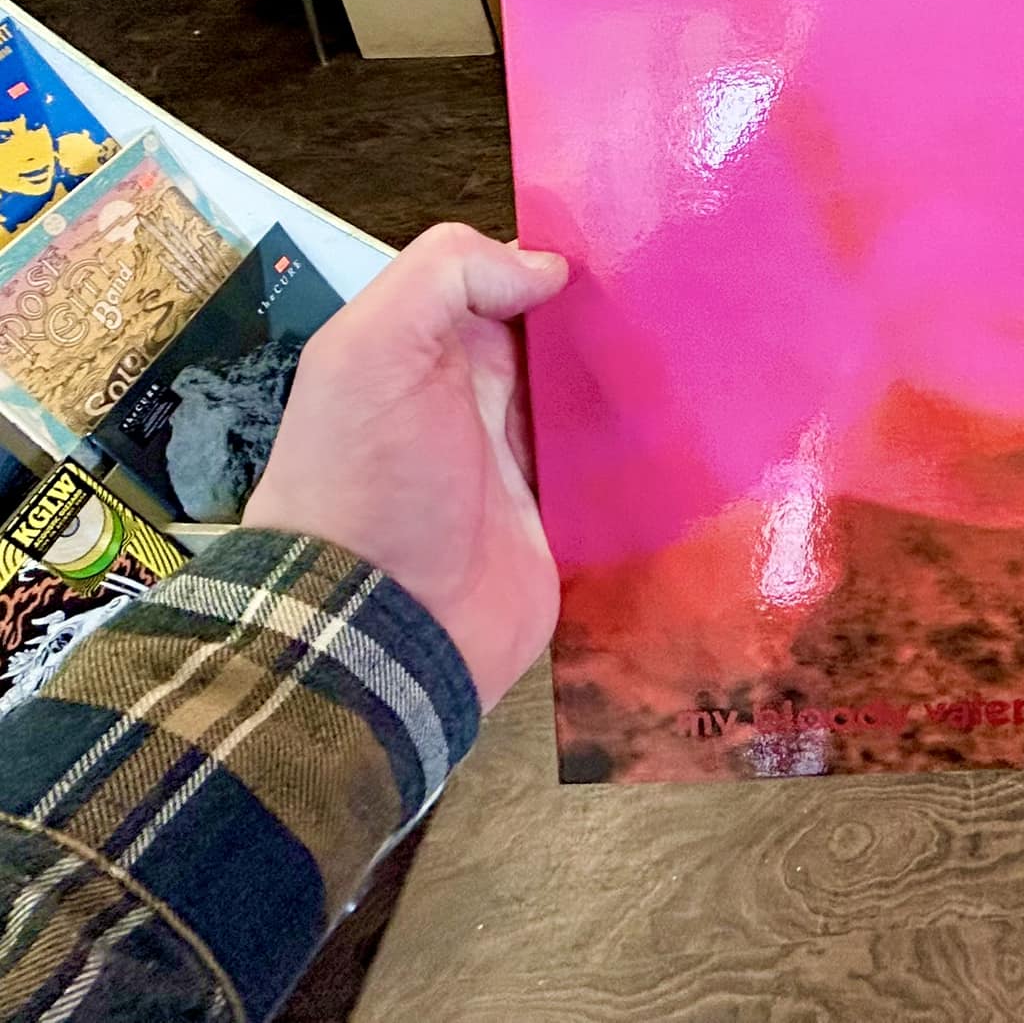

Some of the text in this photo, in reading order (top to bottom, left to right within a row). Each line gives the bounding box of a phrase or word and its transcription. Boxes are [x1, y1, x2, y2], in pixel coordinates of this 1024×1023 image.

[0, 245, 70, 365] ROSE
[92, 260, 133, 330] Band
[11, 473, 76, 548] KGLW
[676, 708, 738, 739] my
